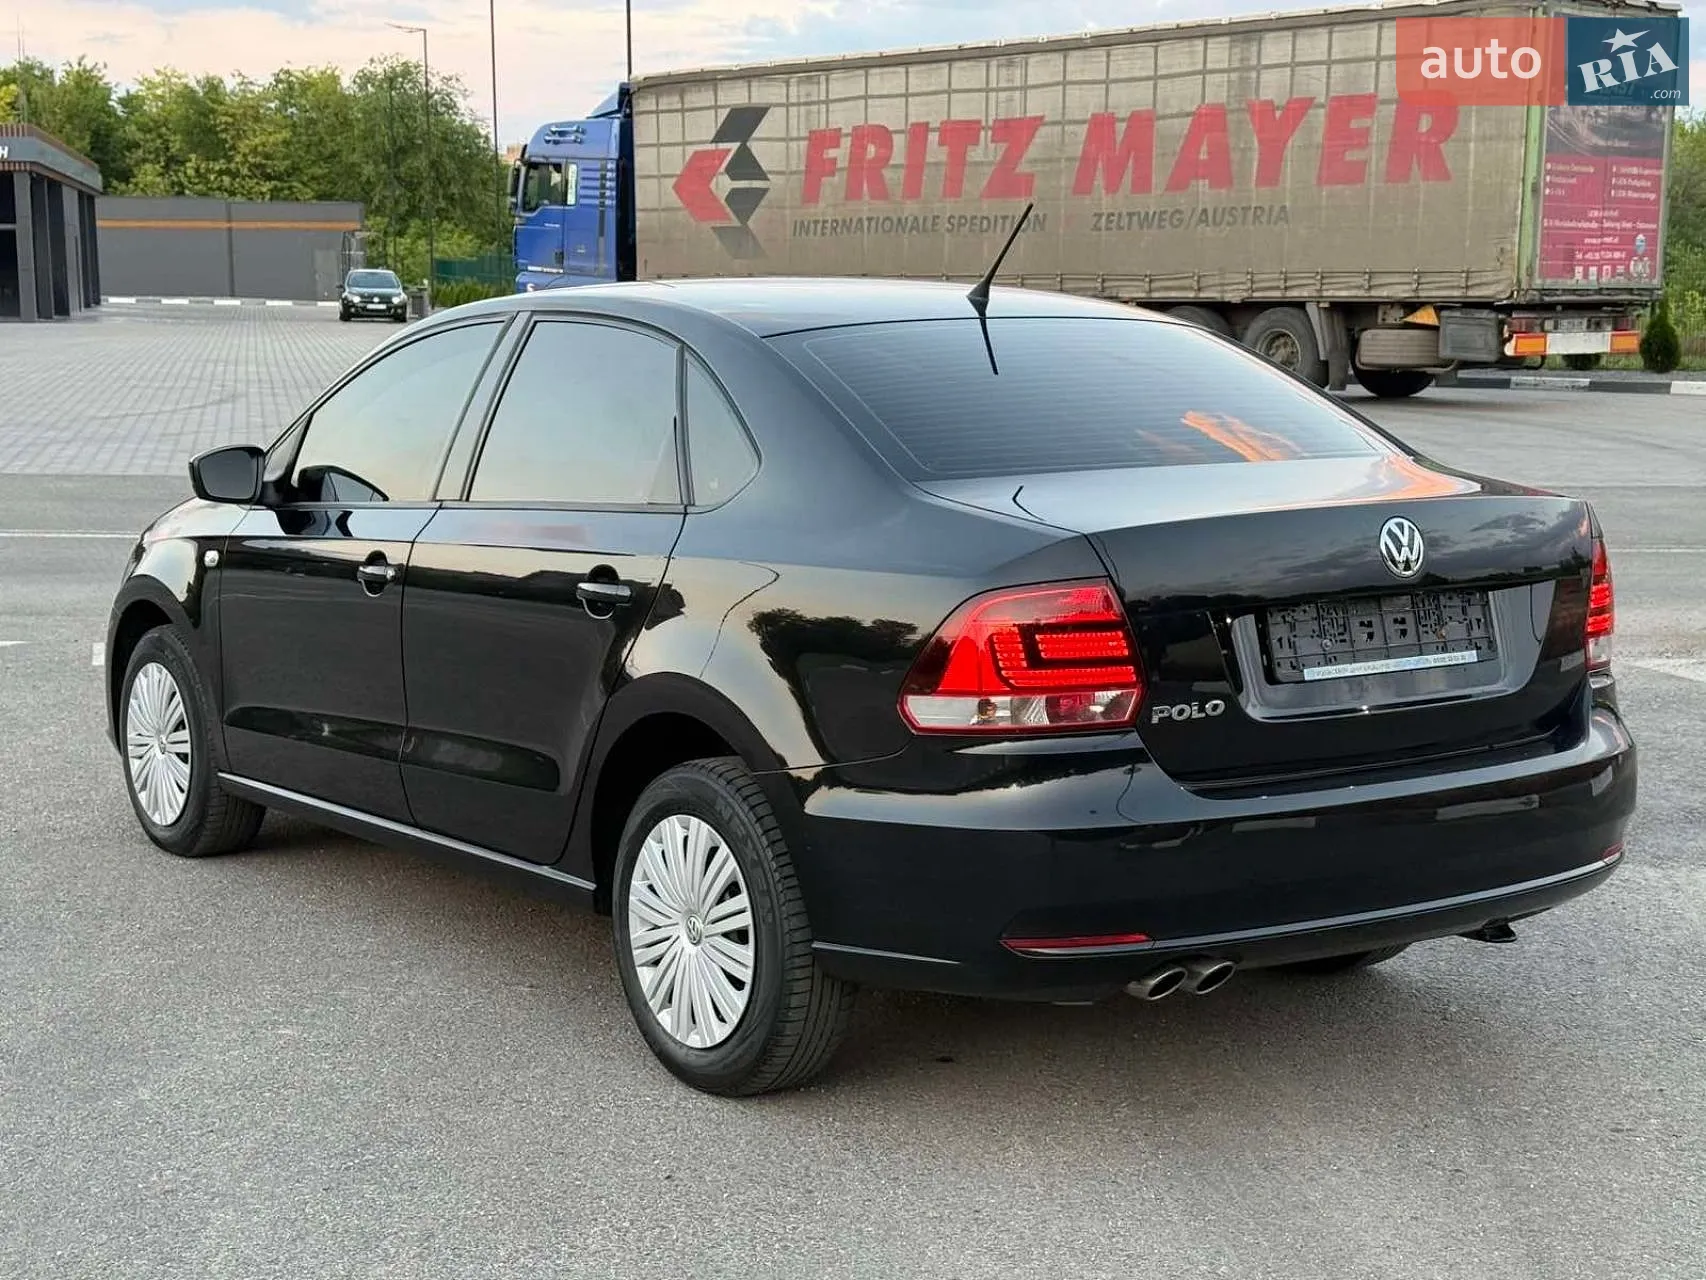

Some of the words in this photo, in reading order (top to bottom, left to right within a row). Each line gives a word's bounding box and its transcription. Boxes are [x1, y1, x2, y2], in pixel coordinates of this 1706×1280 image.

[801, 114, 1046, 205] FRITZ
[1071, 91, 1460, 196] MAYER
[792, 213, 941, 238] INTERNATIONALE
[1090, 205, 1289, 232] ZELTWEG/AUSTRIA
[1151, 699, 1226, 725] POLO
